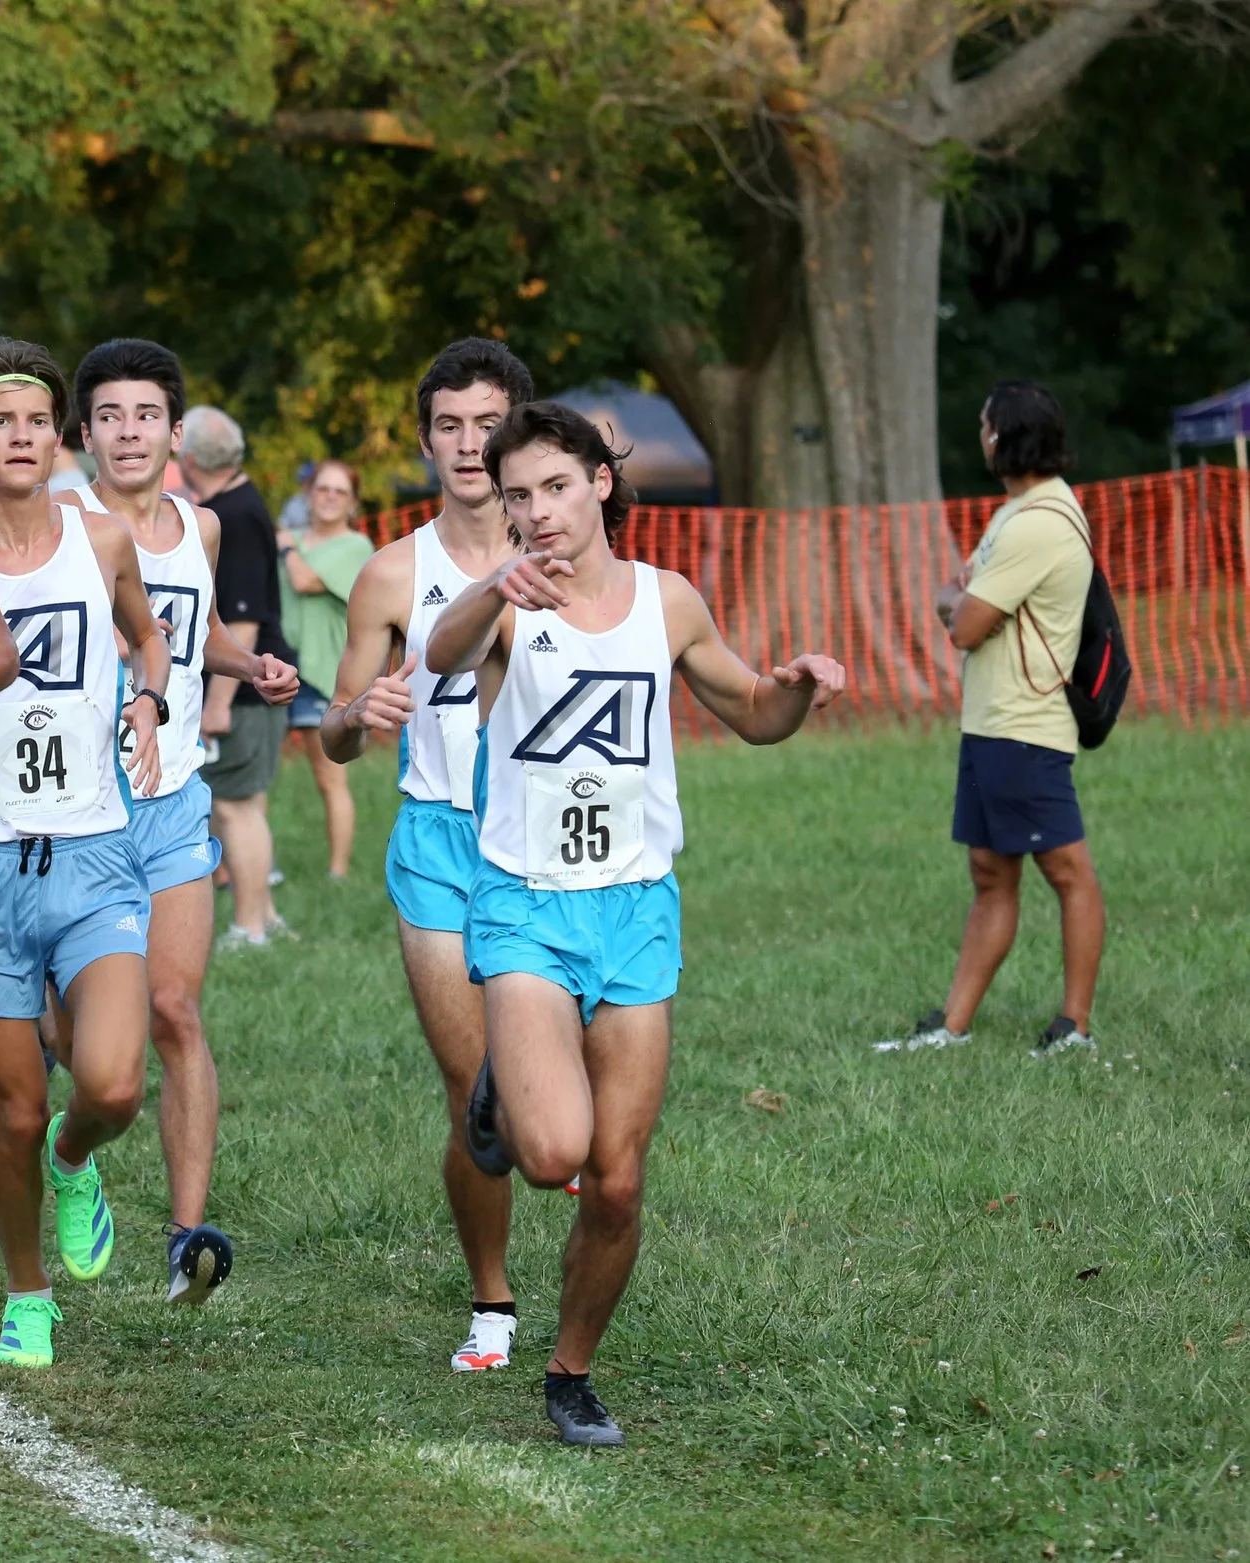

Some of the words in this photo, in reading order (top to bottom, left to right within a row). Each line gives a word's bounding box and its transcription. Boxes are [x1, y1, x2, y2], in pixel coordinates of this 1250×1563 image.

[421, 596, 448, 607] adidas
[528, 643, 558, 653] adidas
[18, 709, 28, 722] EYE
[30, 704, 58, 717] OPENER
[16, 735, 67, 794] 34
[565, 776, 576, 789] EYE
[578, 771, 607, 786] OPENER
[561, 804, 610, 865] 35
